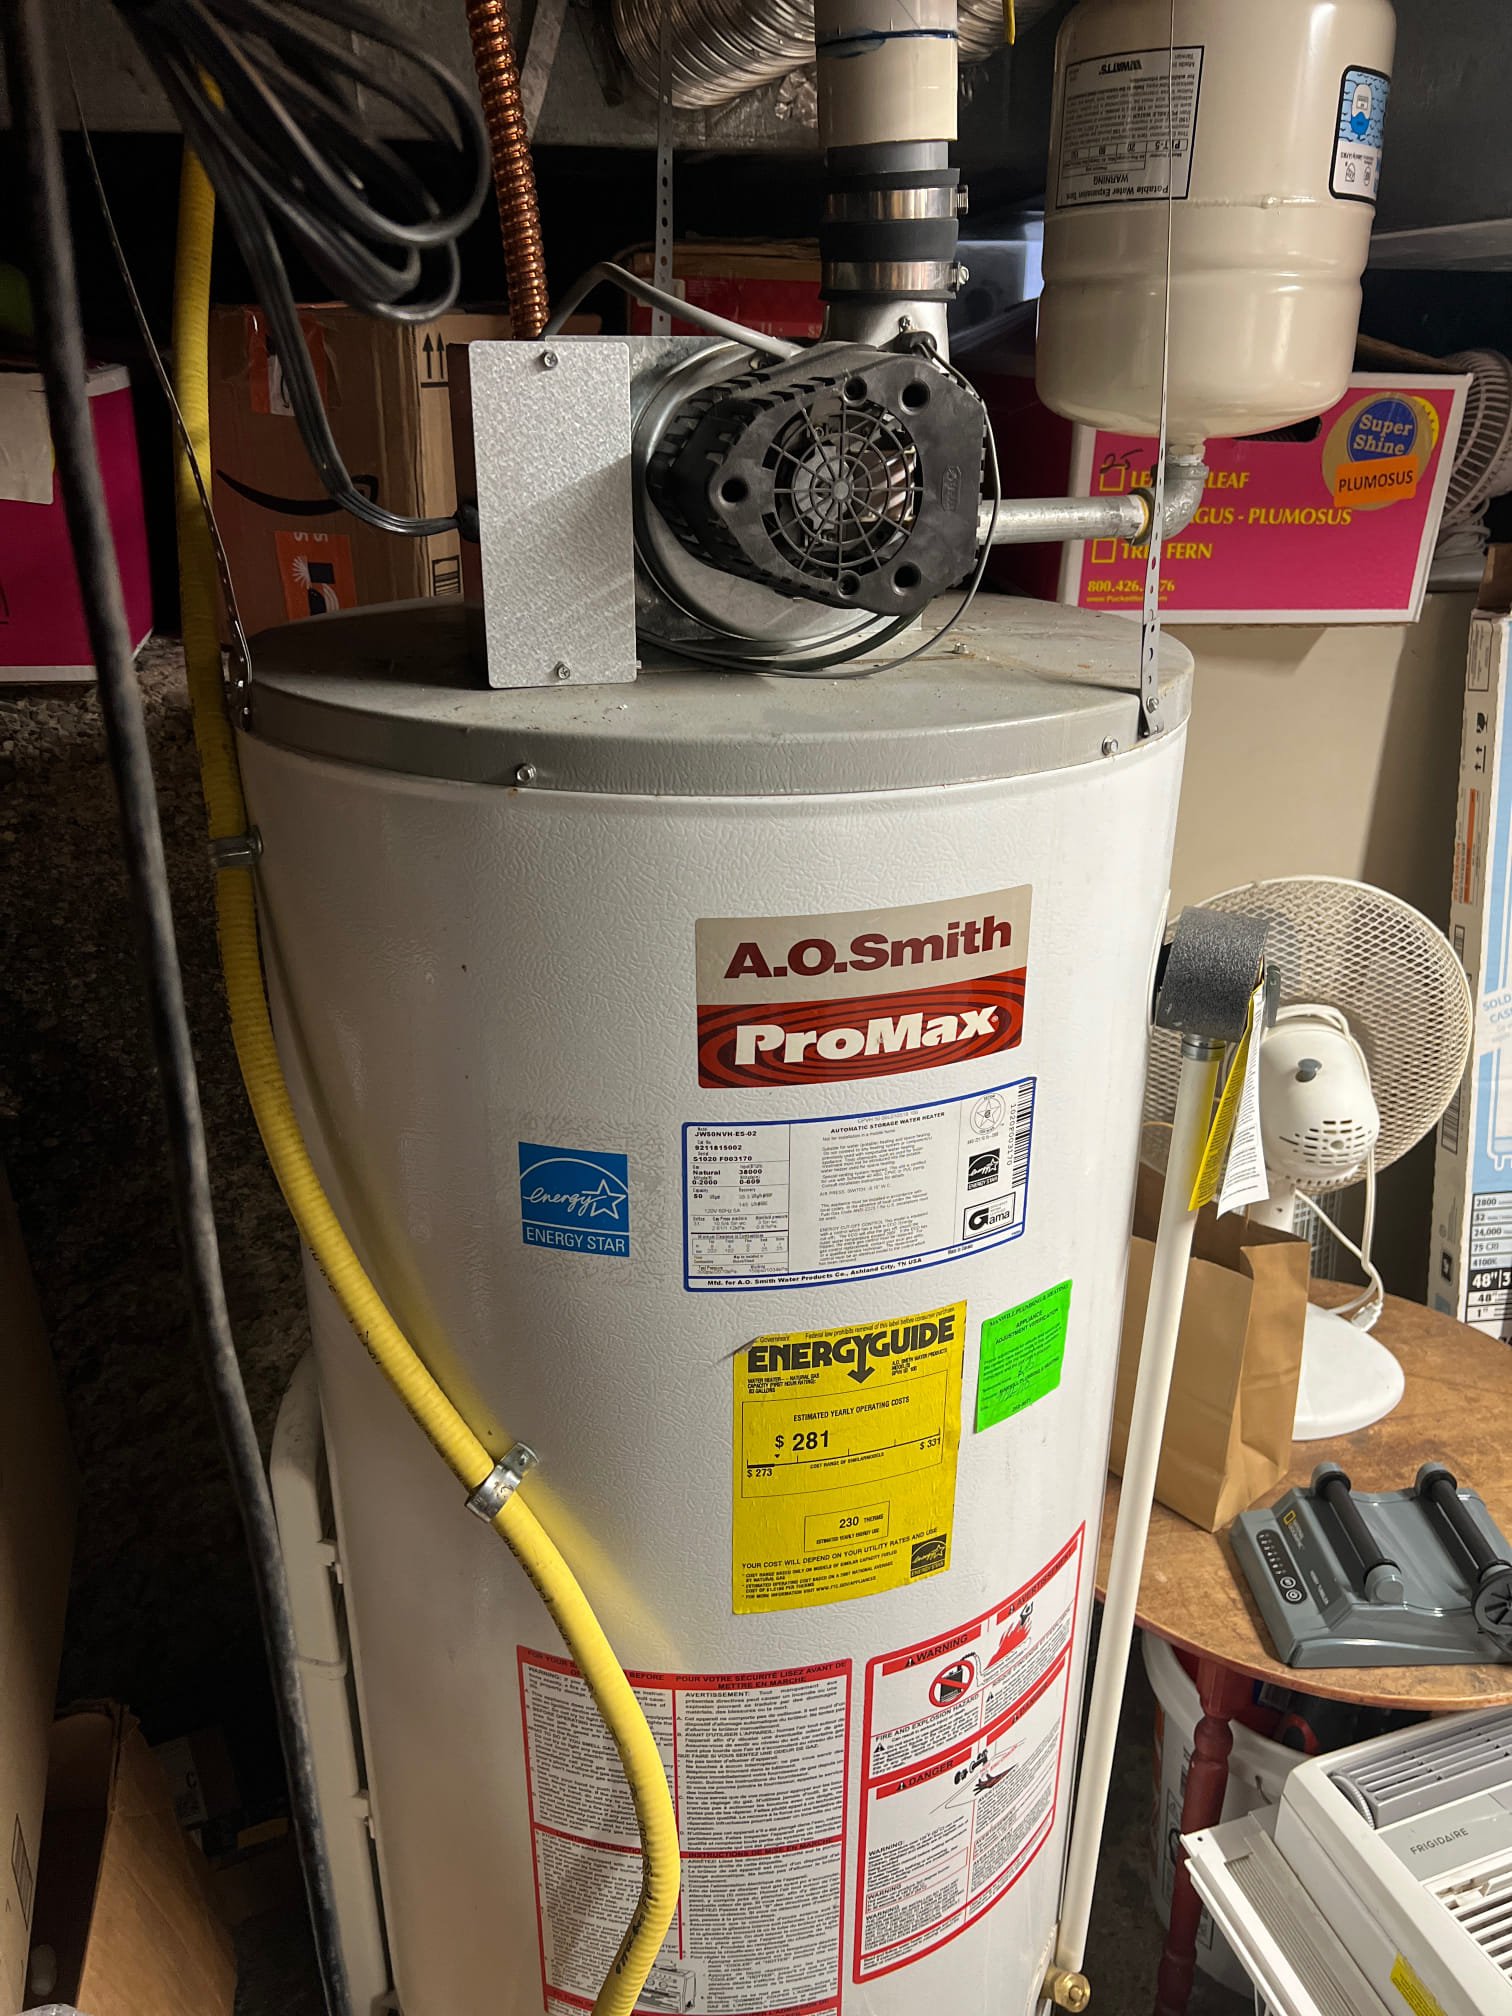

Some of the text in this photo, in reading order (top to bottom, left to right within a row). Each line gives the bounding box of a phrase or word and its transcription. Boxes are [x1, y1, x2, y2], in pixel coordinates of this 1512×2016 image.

[1093, 174, 1129, 185] WARNING
[1136, 185, 1169, 195] Potable
[1112, 187, 1134, 197] Water
[1359, 414, 1413, 437] Super
[1353, 434, 1405, 456] Shine
[1338, 469, 1414, 492] PLUMOSUS
[1248, 507, 1352, 525] PLUMOSUS
[1166, 543, 1213, 560] FERN
[724, 915, 1012, 979] A.O.Smith
[1482, 993, 1512, 1011] SOLD
[734, 1005, 998, 1065] ProMax
[830, 1112, 945, 1134] AUTOMATIC STORAGE WATER HEATER
[1476, 1198, 1497, 1207] 2800
[526, 1226, 625, 1253] ENERGY STAR
[1474, 1227, 1502, 1237] 24,000
[801, 1272, 833, 1281] Products
[850, 1265, 879, 1275] Ashland
[880, 1263, 896, 1271] City,
[908, 1257, 922, 1266] USA
[747, 1314, 955, 1375] ENERGYGUIDE
[793, 1396, 910, 1422] ESTIMATED YEARLY OPERATING COSTS
[775, 1430, 829, 1451] $ 281
[919, 1437, 941, 1451] $ 331
[746, 1468, 773, 1478] $ 273
[839, 1513, 884, 1529] 230 THERMS
[763, 1560, 782, 1568] COST
[802, 1554, 830, 1564] DEPEND
[844, 1548, 863, 1557] YOUR
[863, 1543, 888, 1553] UTILITY
[890, 1536, 910, 1547] RATES
[911, 1532, 924, 1540] AND
[925, 1528, 938, 1536] USE
[916, 1634, 968, 1662] WARNING
[629, 1671, 665, 1681] BEFORE
[780, 1669, 803, 1678] LISEZ
[806, 1665, 833, 1675] AVANT
[717, 1682, 753, 1690] METTRE
[769, 1677, 807, 1688] MARCHE
[875, 1693, 979, 1742] FIRE AND EXPLOSION HAZARD
[908, 1759, 954, 1786] DANGER
[1409, 1827, 1469, 1855] FRIGIDAIRE
